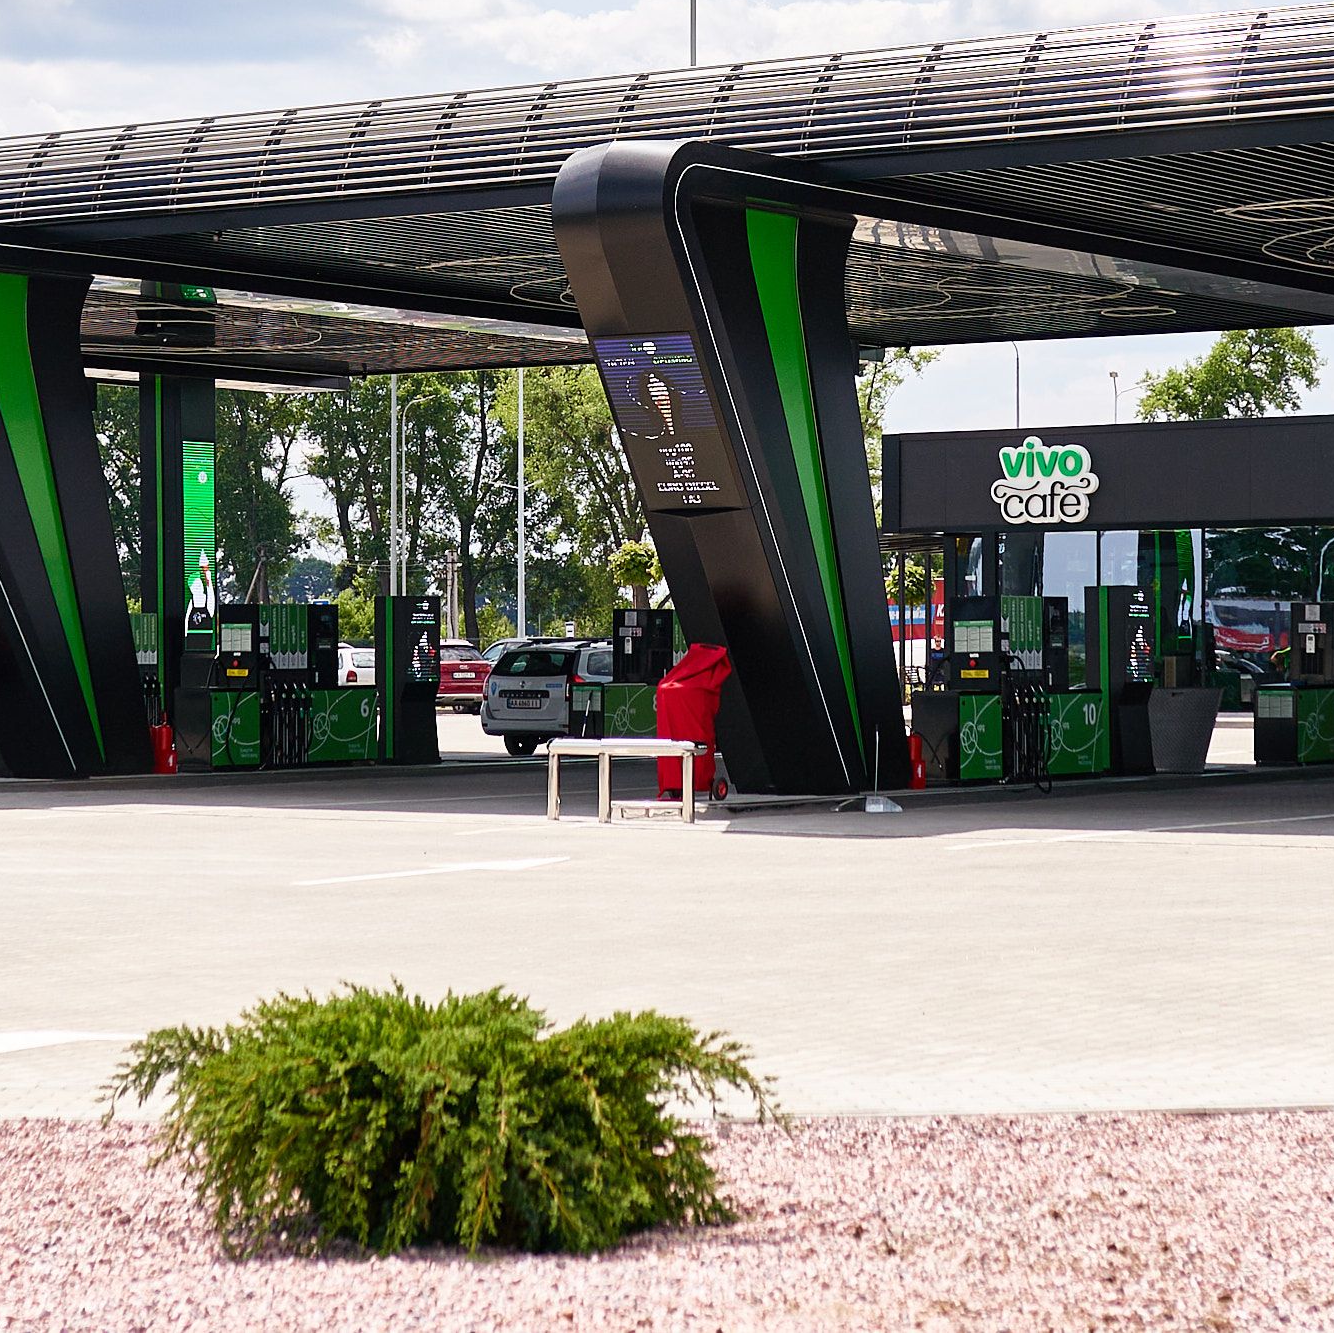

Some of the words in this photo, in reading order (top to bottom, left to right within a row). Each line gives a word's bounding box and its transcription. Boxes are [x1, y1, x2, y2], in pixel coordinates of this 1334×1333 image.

[1001, 441, 1083, 478] vivo
[360, 698, 369, 718] 6
[1082, 703, 1097, 726] 10
